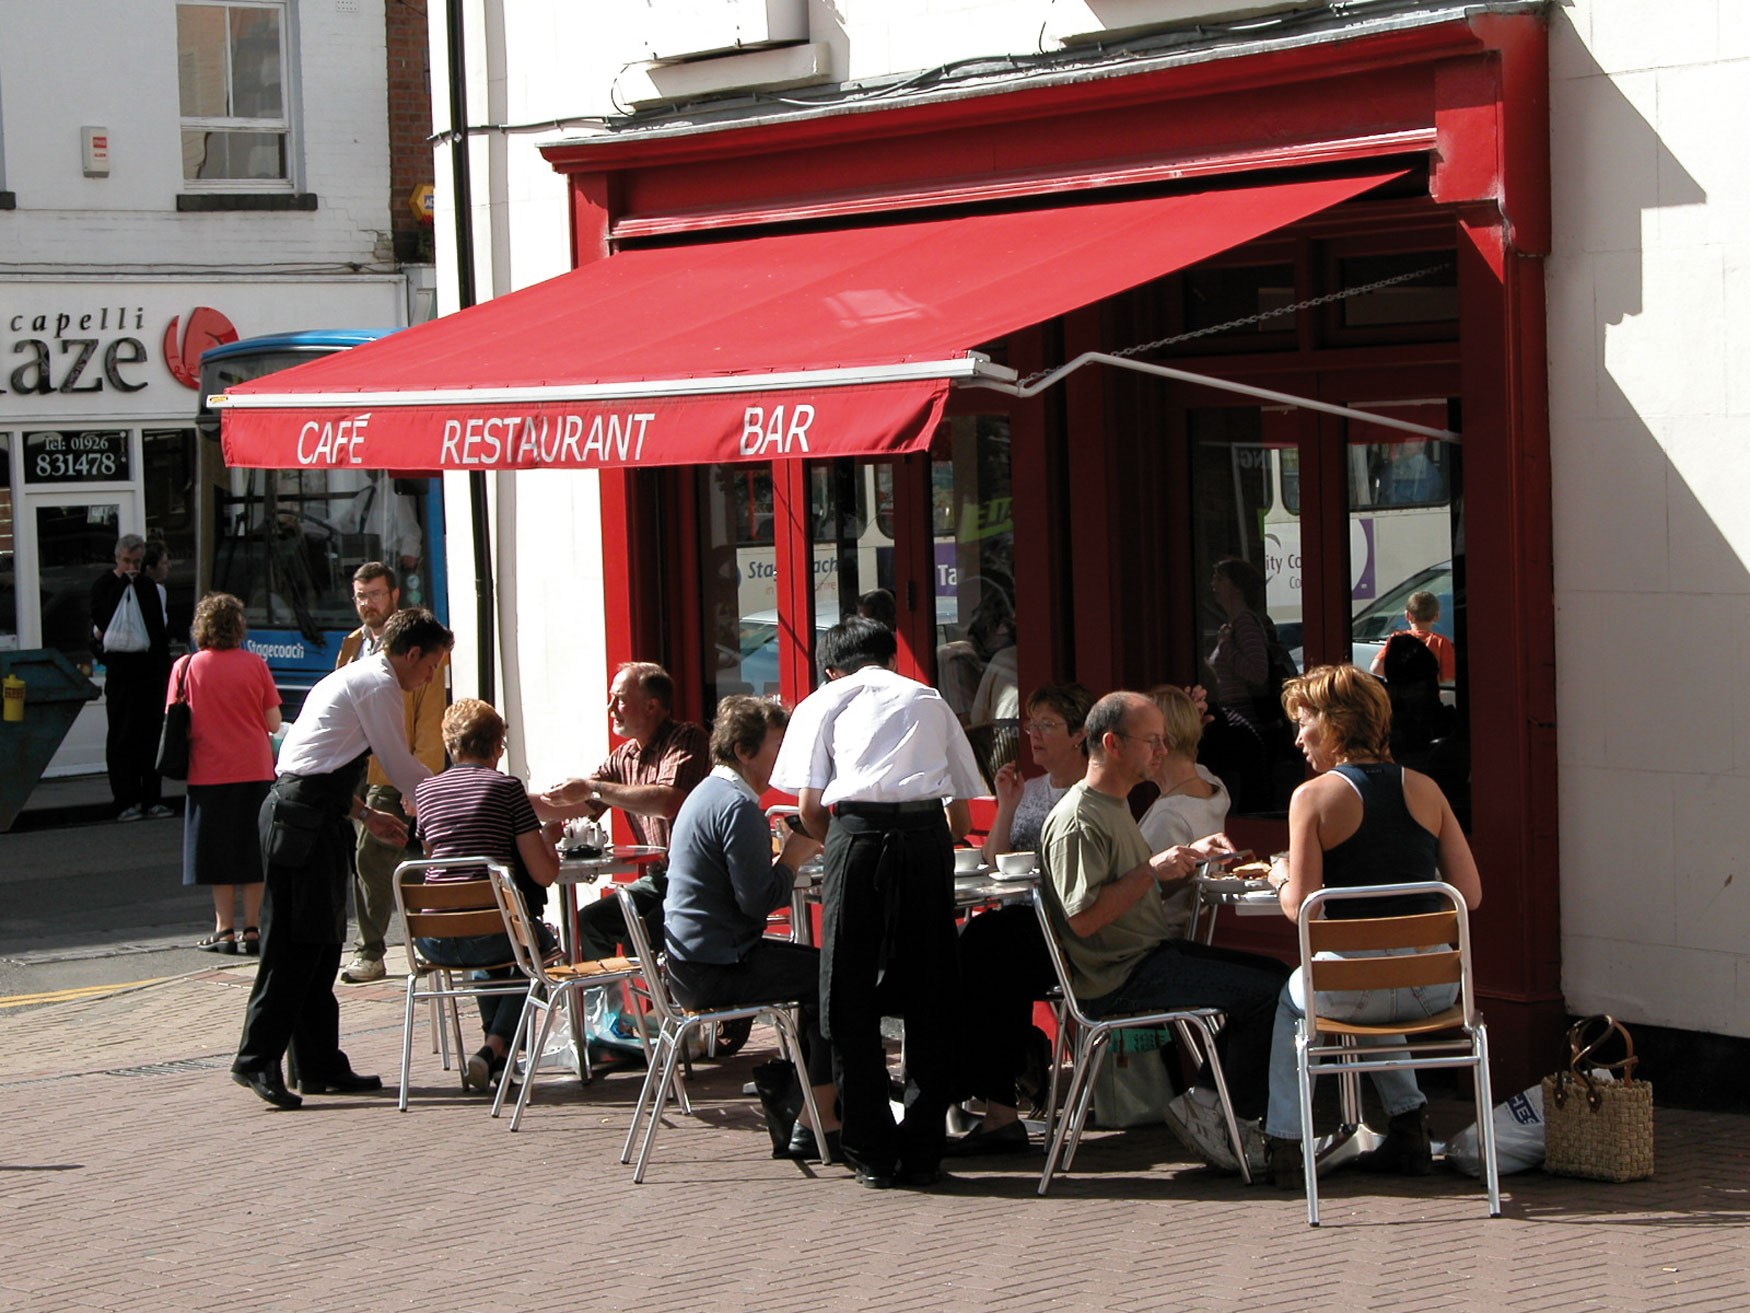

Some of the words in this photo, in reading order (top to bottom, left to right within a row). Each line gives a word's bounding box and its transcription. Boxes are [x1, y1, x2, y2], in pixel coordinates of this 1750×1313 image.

[11, 307, 144, 338] capelli
[0, 337, 148, 395] aze
[45, 437, 66, 450] Tel:
[70, 437, 108, 450] 01926
[297, 412, 371, 464] CAFÉ
[440, 413, 655, 465] RESTAURANT
[739, 404, 815, 456] BAR
[36, 452, 116, 476] 831478
[247, 640, 304, 661] Stagecoach
